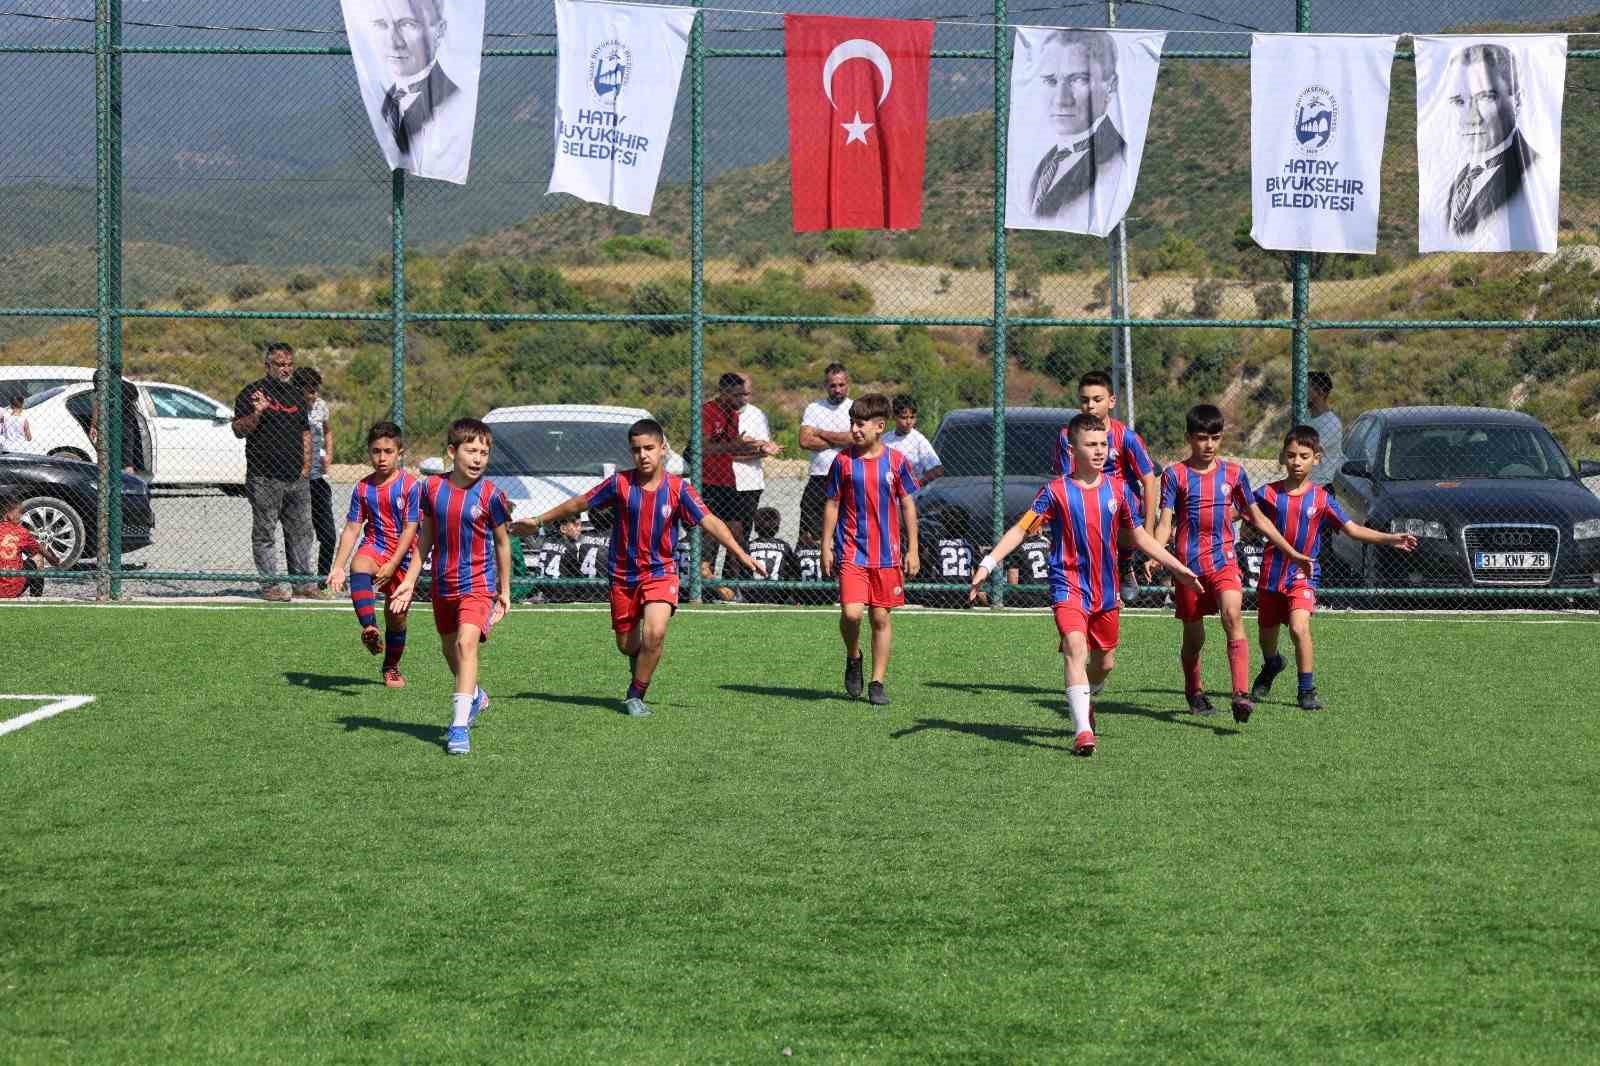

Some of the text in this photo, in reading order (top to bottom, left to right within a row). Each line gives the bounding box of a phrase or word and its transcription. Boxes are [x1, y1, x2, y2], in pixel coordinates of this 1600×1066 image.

[940, 546, 972, 576] 22
[1484, 555, 1545, 567] 31 KNV 26
